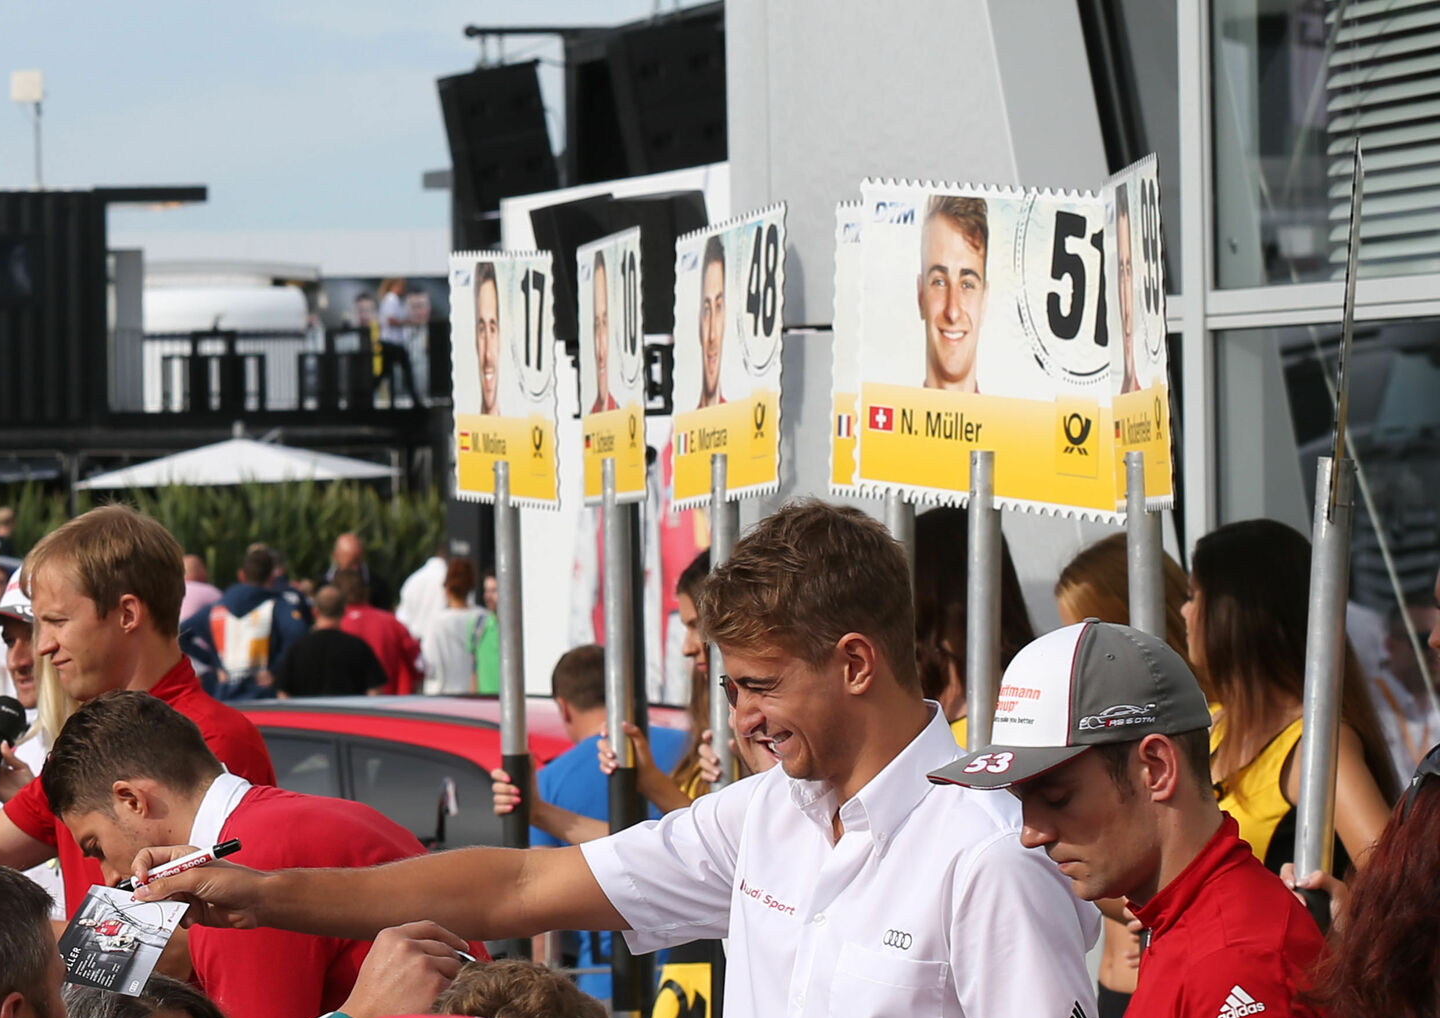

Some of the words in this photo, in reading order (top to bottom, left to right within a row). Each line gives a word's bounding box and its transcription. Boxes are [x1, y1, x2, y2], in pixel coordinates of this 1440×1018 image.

[872, 201, 915, 225] DTM
[1141, 178, 1160, 315] 99
[746, 223, 779, 337] 48
[1047, 210, 1109, 347] 51
[521, 267, 545, 372] 17
[621, 249, 637, 356] 10
[699, 428, 728, 451] Mortara
[900, 407, 918, 435] N.
[925, 410, 983, 443] Müller
[962, 751, 1016, 774] 53
[181, 856, 208, 871] 3000
[763, 894, 796, 916] Sport
